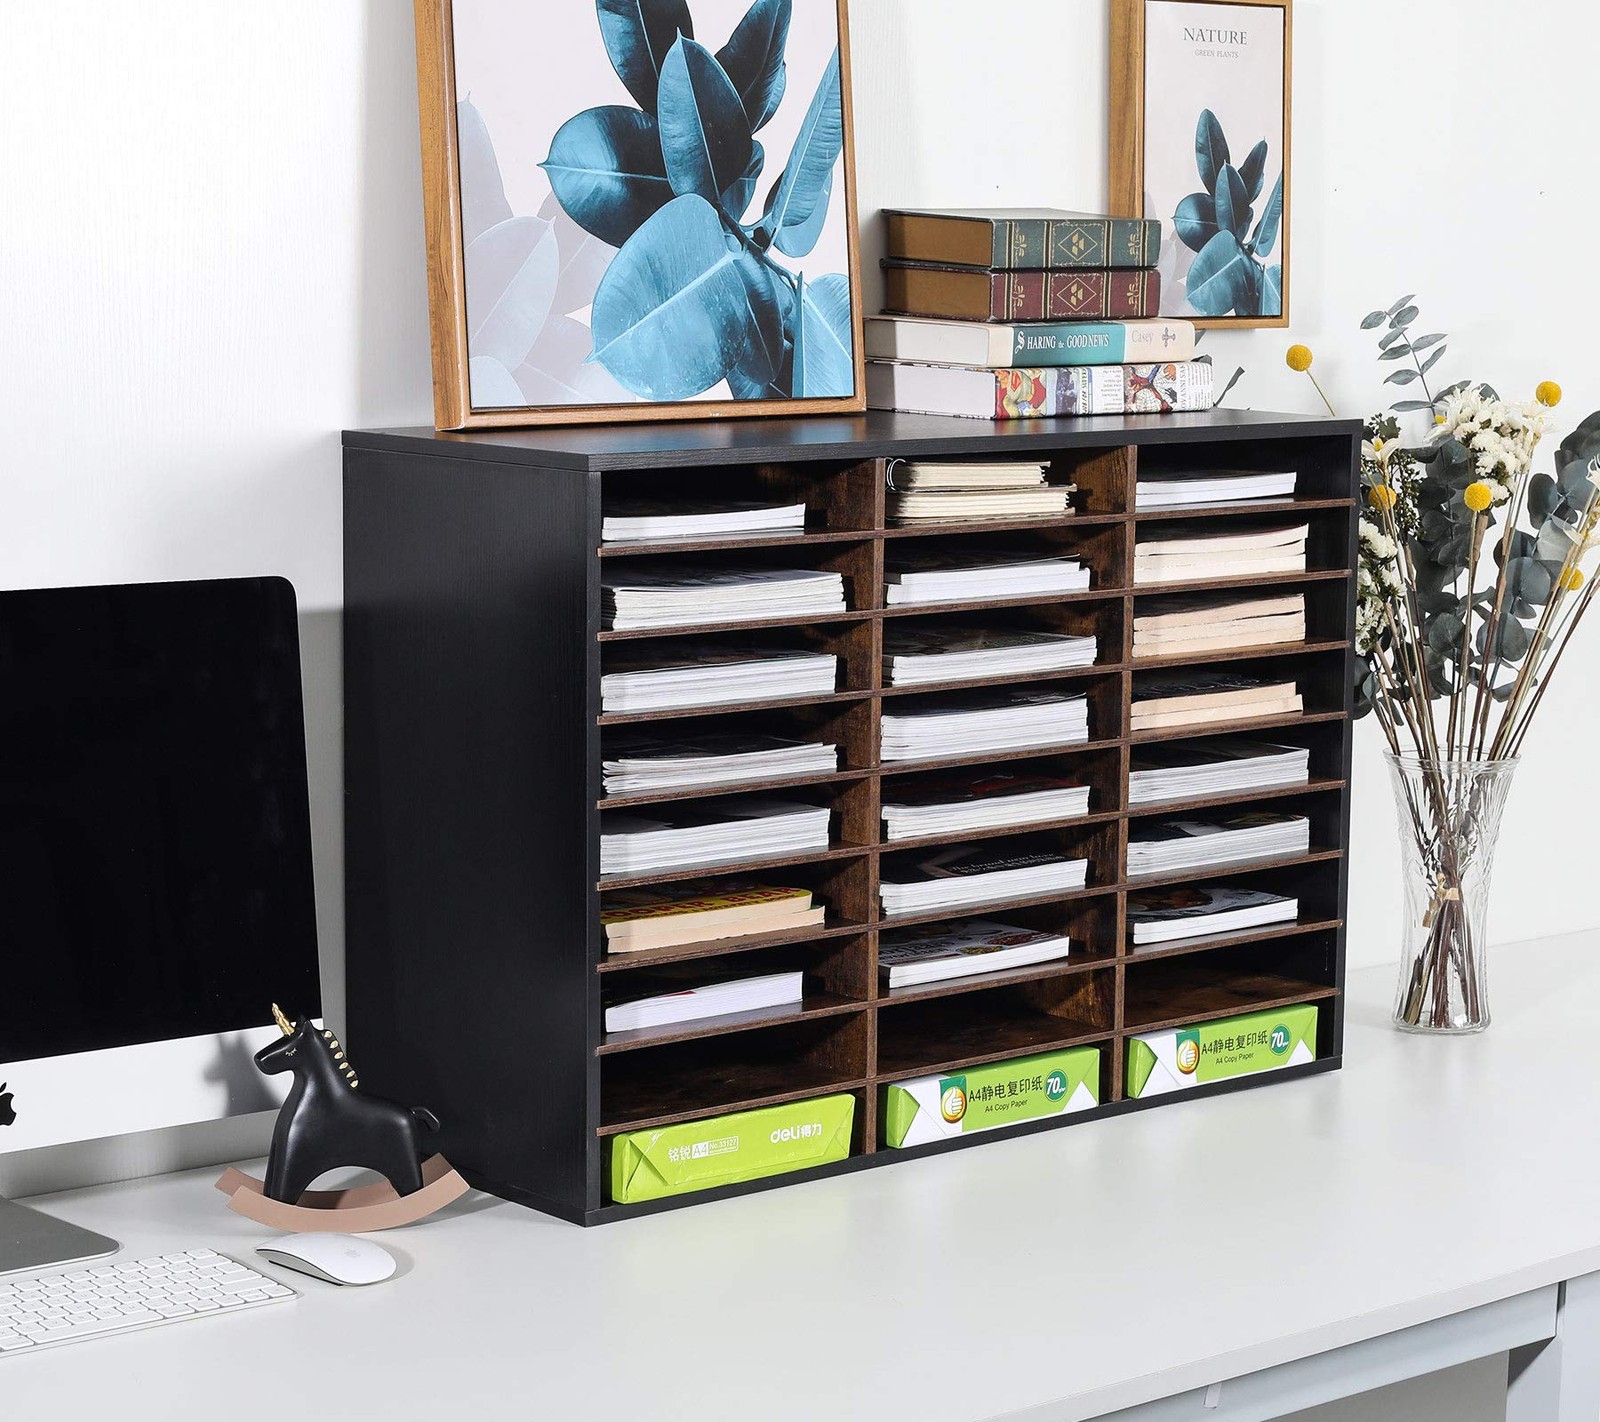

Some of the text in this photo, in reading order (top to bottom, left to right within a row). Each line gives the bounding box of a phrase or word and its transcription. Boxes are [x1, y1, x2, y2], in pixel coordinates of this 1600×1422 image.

[1183, 28, 1247, 45] NATURE
[1194, 49, 1239, 59] GREEN PLANTS
[1066, 334, 1088, 349] GOOD
[1088, 333, 1110, 348] NEWS
[1131, 329, 1154, 344] Casey
[721, 887, 801, 903] BEAR
[1202, 1030, 1268, 1054] A4静电复印纸
[1271, 1031, 1283, 1048] 70
[1224, 1055, 1238, 1064] Copy
[1239, 1053, 1254, 1061] Paper
[969, 1075, 1043, 1103] A4静电复印纸
[1047, 1077, 1060, 1095] 70
[985, 1099, 1028, 1113] A4 Copy Paper
[693, 1144, 707, 1157] A4
